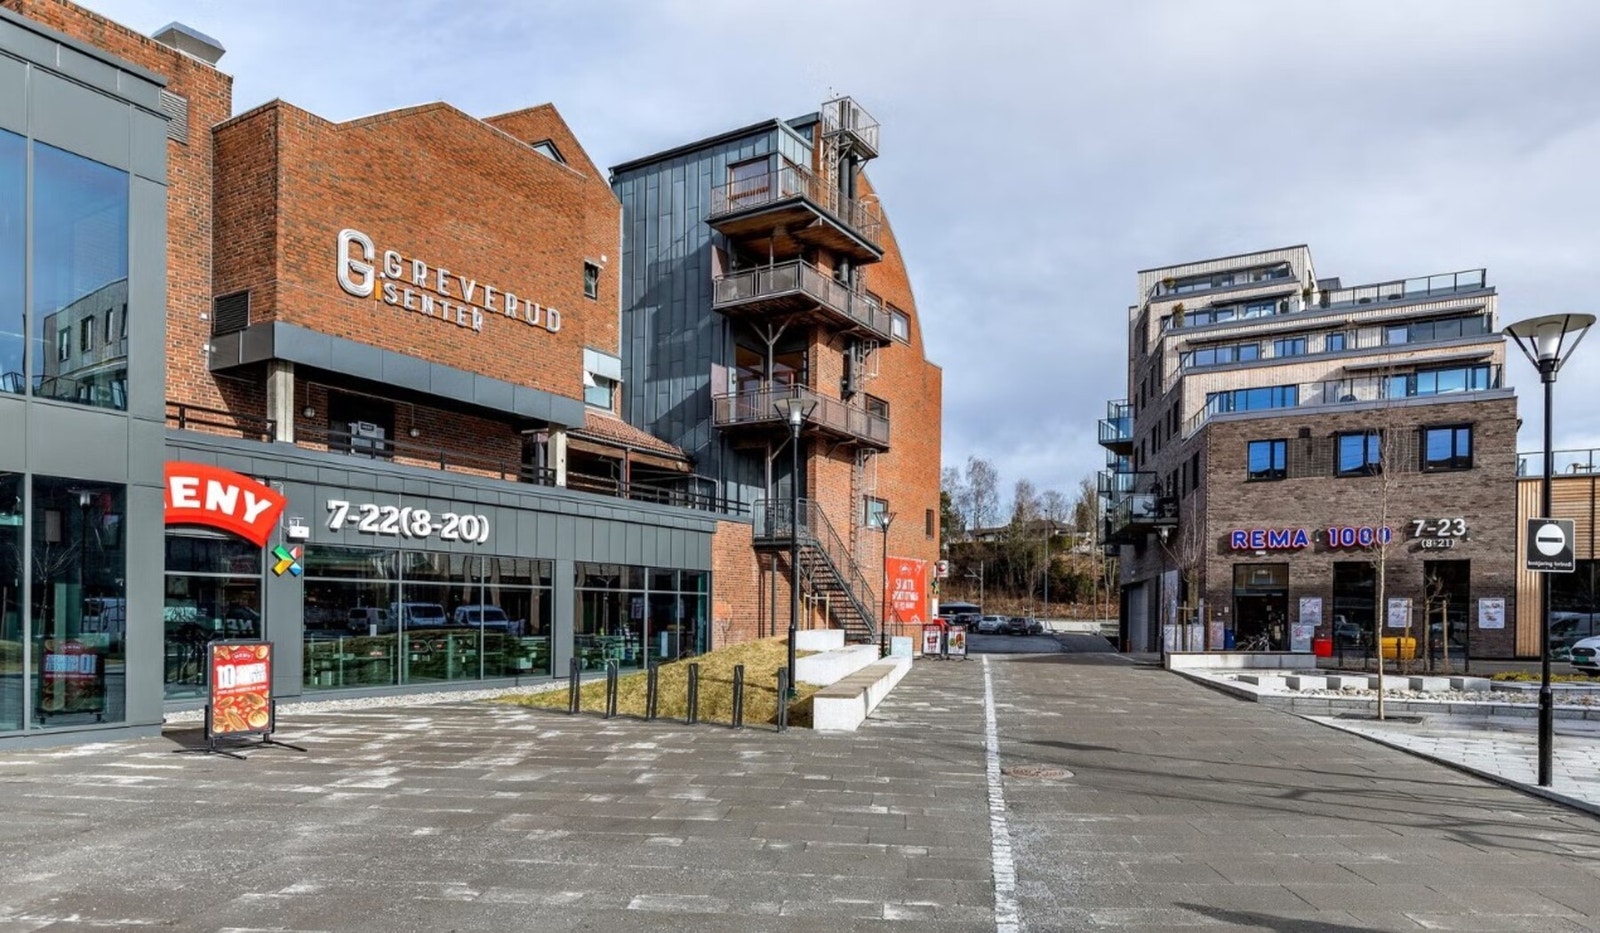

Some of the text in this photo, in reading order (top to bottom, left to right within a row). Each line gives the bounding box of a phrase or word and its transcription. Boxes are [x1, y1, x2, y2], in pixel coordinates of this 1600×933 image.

[383, 282, 484, 332] SENTER
[384, 250, 561, 333] GREVERUD
[164, 475, 272, 524] ENY
[326, 499, 490, 544] 7-22(8-20)
[1231, 526, 1392, 548] REMA 1000
[1412, 518, 1466, 537] 7-23
